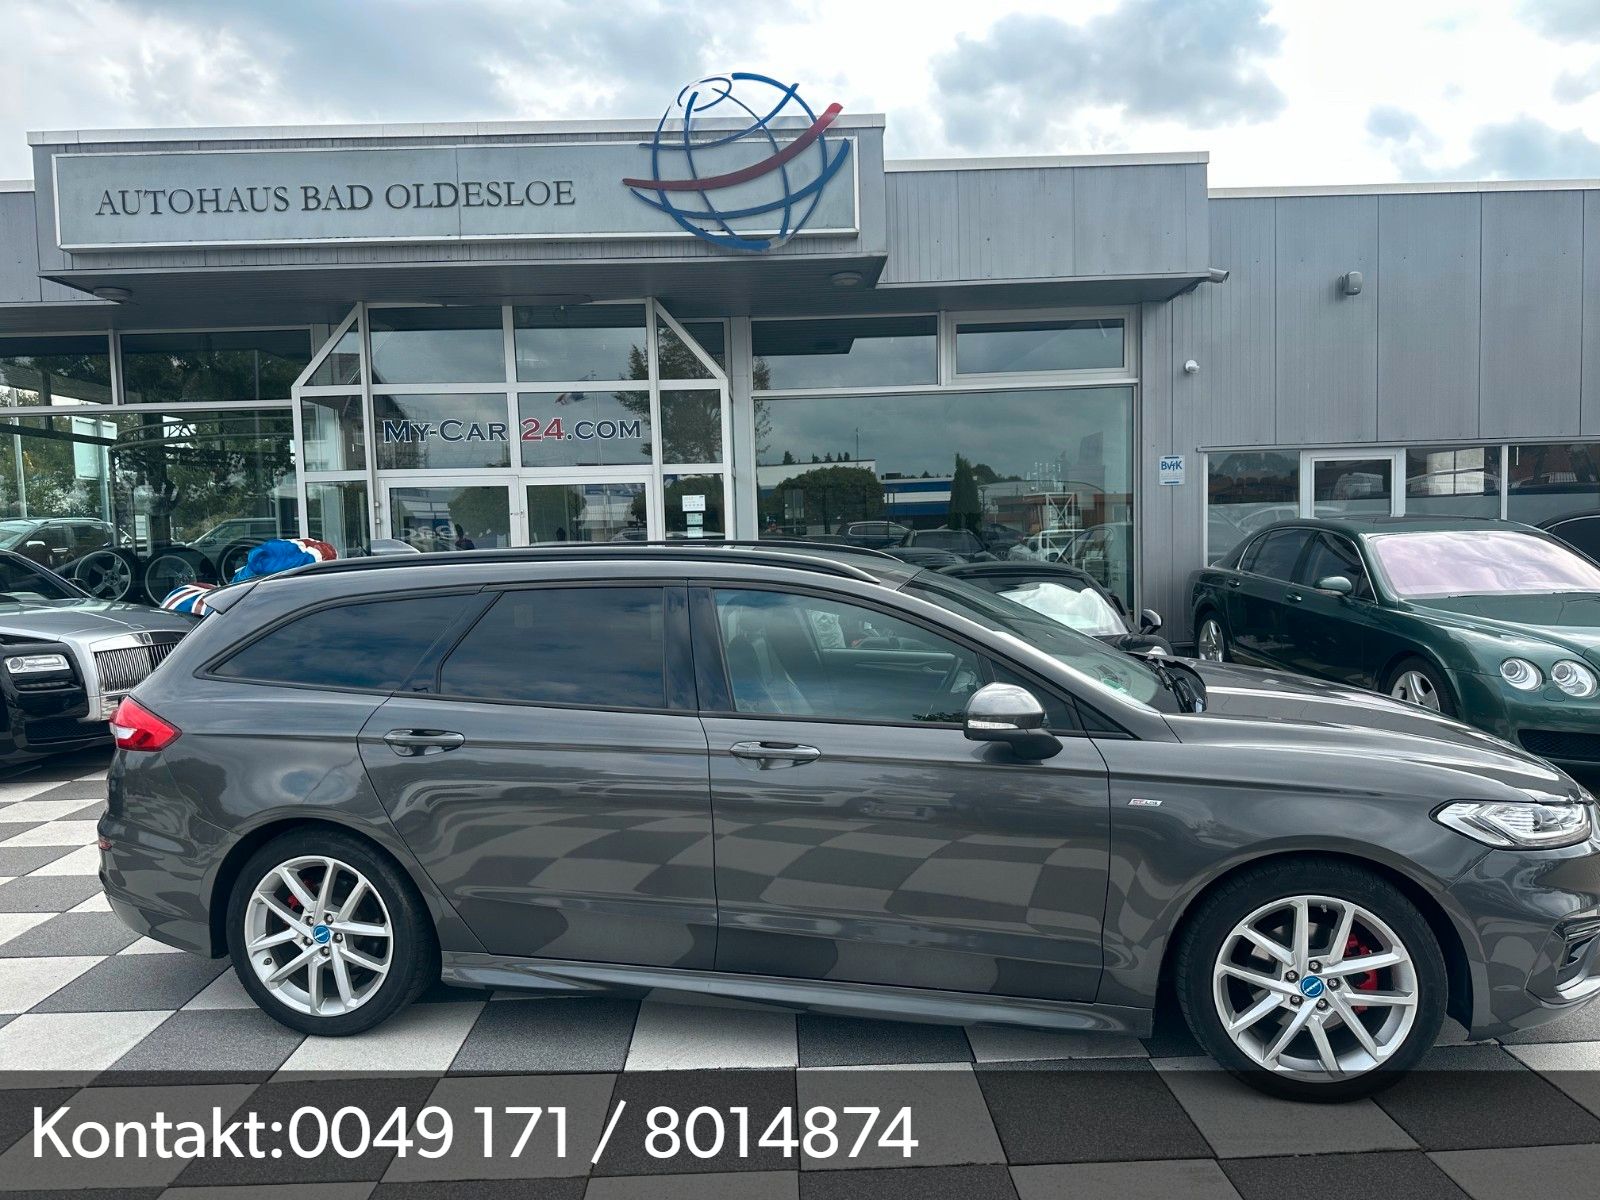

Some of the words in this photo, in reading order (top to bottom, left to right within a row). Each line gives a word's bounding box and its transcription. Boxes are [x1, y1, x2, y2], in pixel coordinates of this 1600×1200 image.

[95, 186, 290, 216] AUTOHAUS
[300, 184, 374, 212] BAD
[384, 180, 576, 209] OLDESLOE
